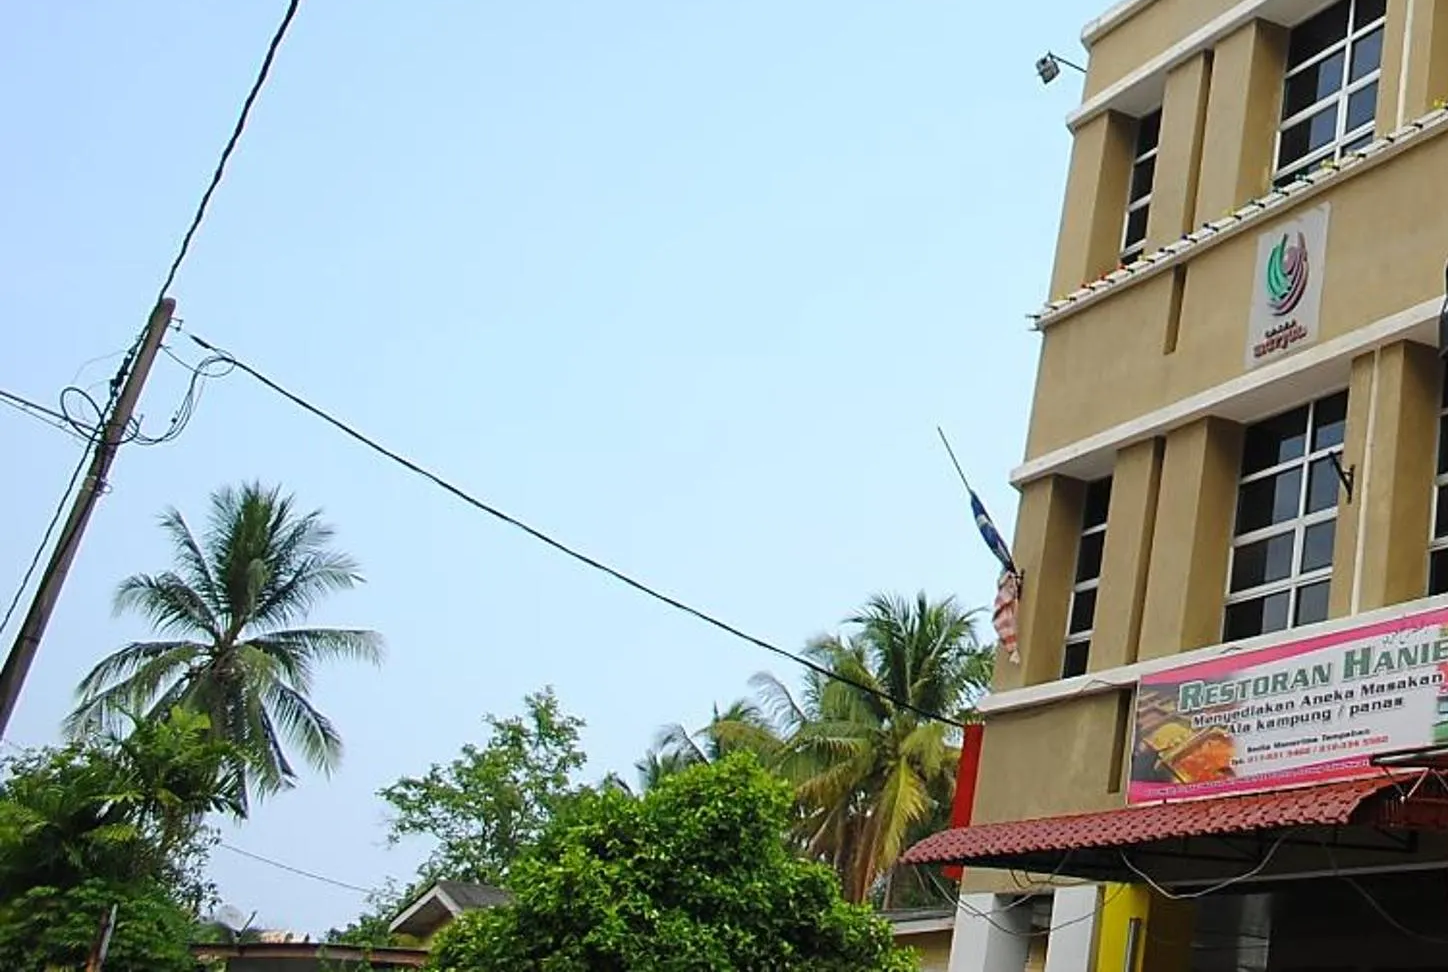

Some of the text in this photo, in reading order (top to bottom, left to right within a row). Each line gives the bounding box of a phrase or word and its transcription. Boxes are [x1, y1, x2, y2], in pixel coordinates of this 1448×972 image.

[1178, 662, 1332, 712] RESTORAN
[1191, 673, 1443, 727] Menyediakan Aneka Masakan
[1256, 709, 1331, 731] kampung
[1349, 696, 1404, 717] panas
